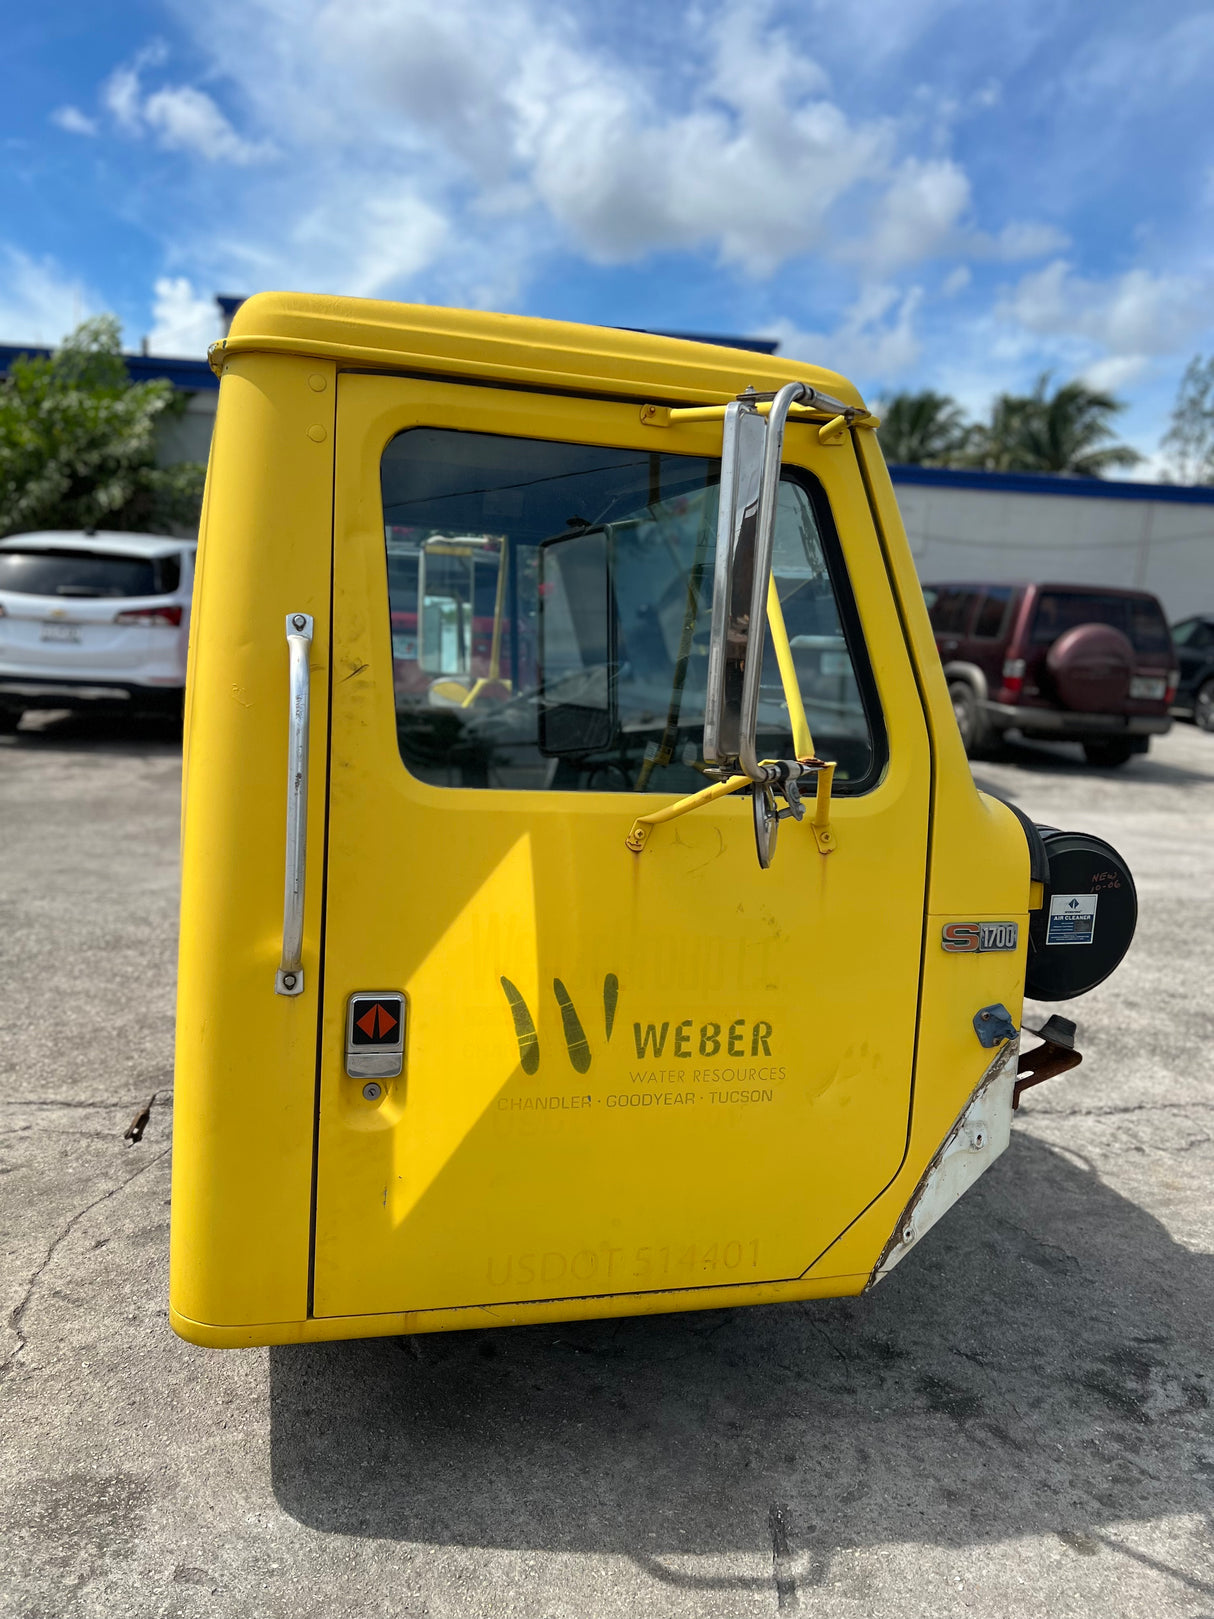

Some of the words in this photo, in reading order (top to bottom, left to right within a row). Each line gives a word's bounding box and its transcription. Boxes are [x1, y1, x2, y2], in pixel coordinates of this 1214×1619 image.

[1090, 880, 1121, 893] 10-06
[1092, 872, 1118, 882] NEW
[633, 1019, 773, 1059] WEBER
[629, 1069, 685, 1084] WATER
[694, 1066, 787, 1082] RESOURCES
[497, 1094, 591, 1111] CHANDLER
[606, 1091, 696, 1108] GOODYEAR
[709, 1089, 773, 1104] TUCSON
[486, 1247, 622, 1288] USDOT
[633, 1237, 760, 1276] 514401
